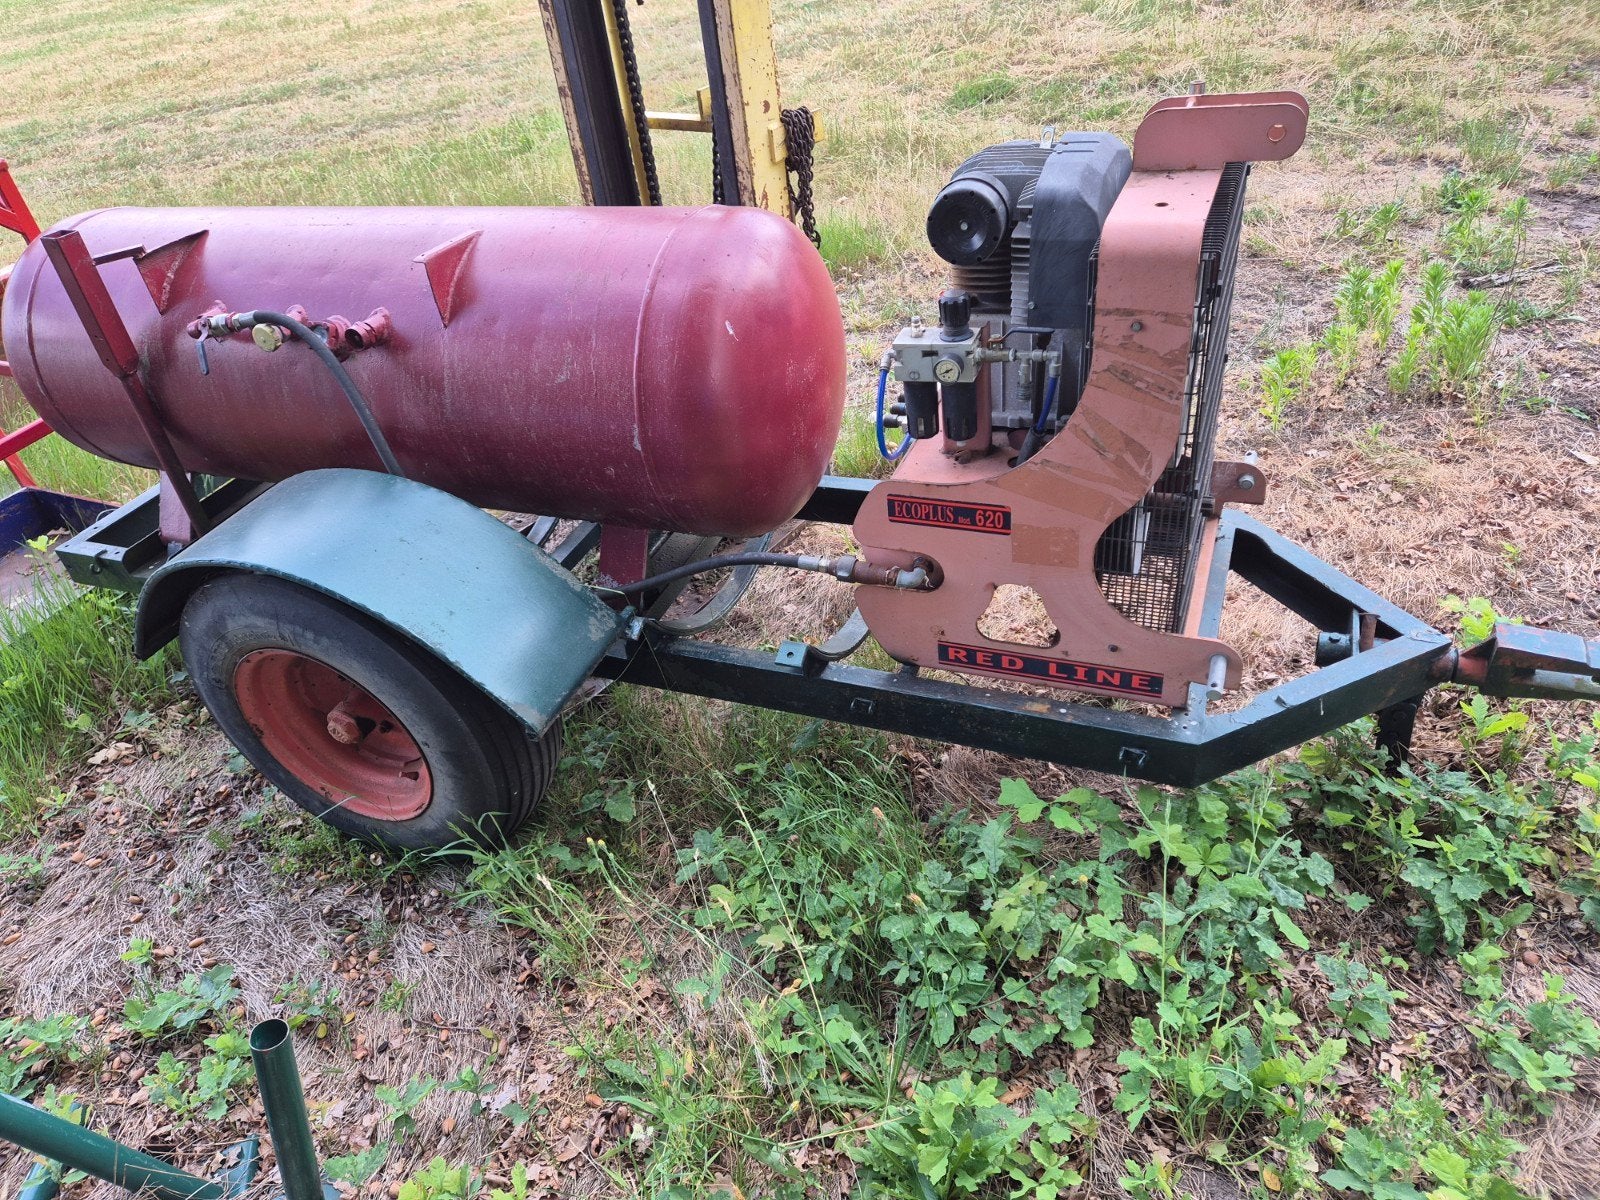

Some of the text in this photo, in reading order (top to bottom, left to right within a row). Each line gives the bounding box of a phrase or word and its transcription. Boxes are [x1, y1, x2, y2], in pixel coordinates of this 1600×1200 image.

[894, 501, 954, 523] ECOPLUS
[975, 510, 1004, 528] 620
[948, 647, 1151, 689] RED LINE
